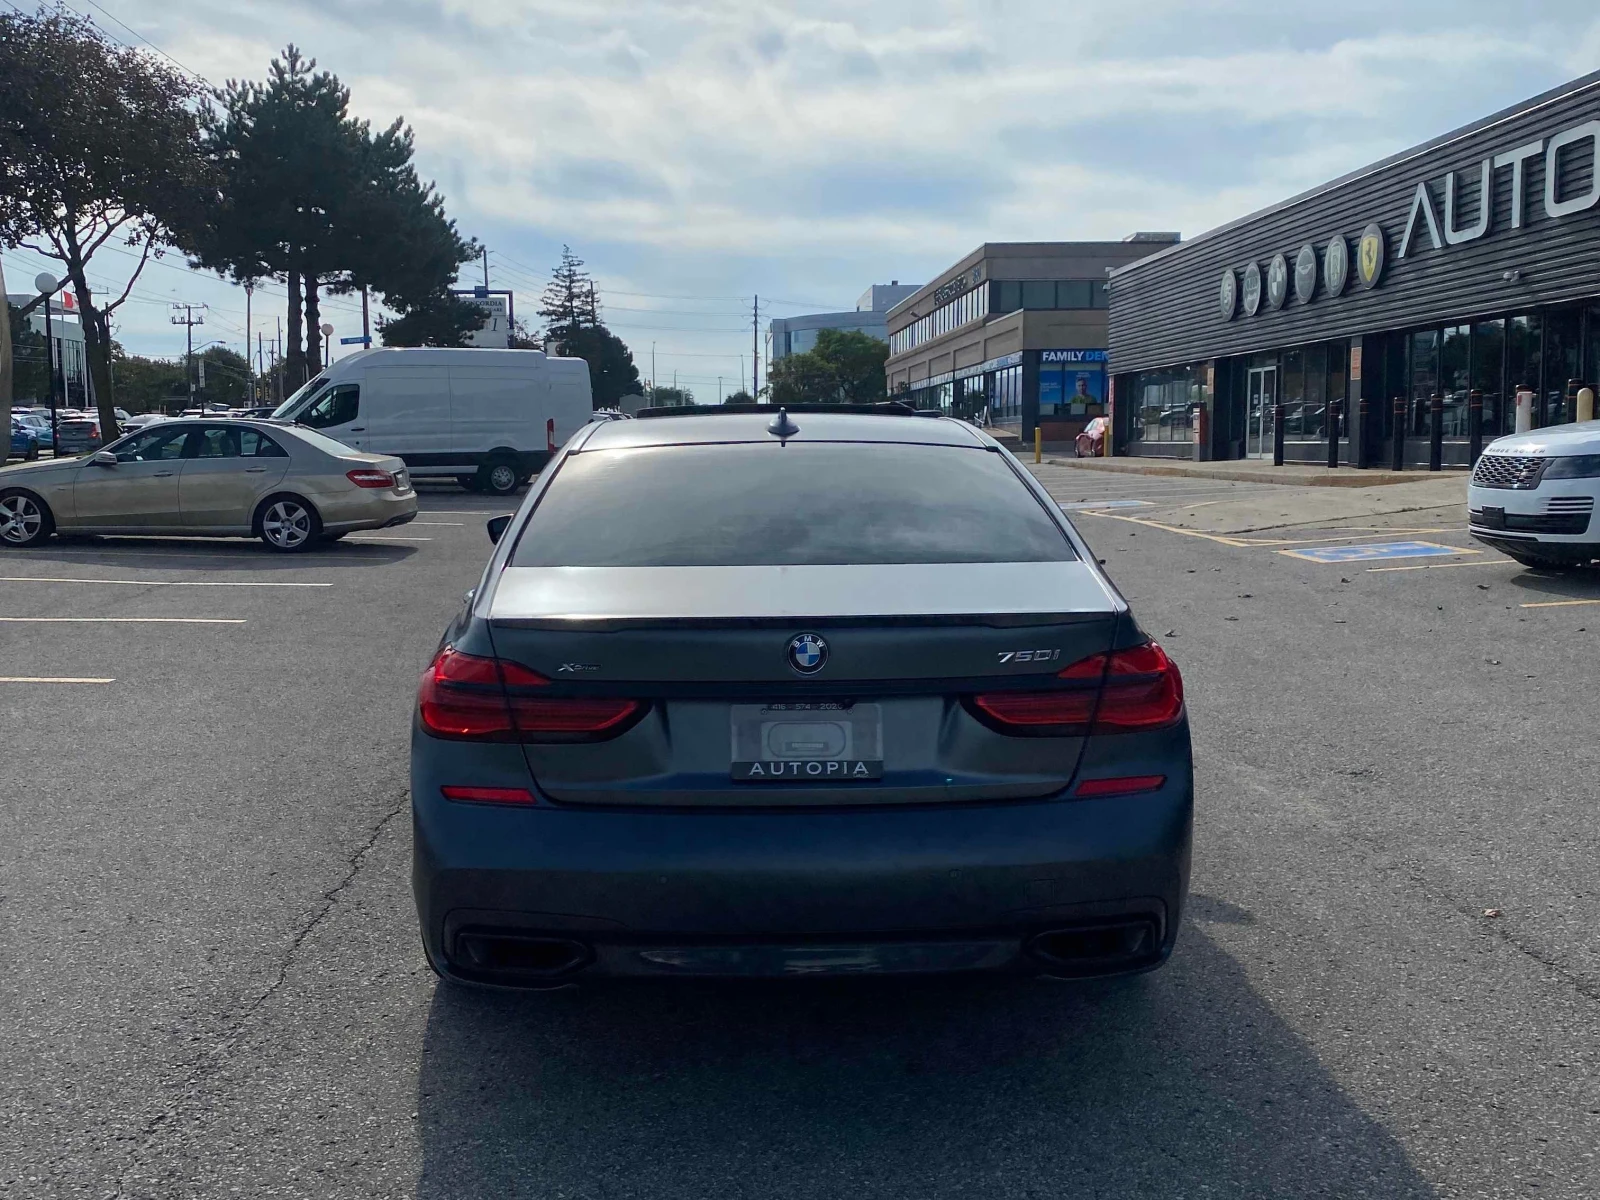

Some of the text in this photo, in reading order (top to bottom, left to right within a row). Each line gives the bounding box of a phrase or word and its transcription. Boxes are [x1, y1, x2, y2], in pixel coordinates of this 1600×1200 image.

[1398, 119, 1600, 259] AUTO
[1042, 351, 1084, 361] FAMILY
[793, 635, 825, 648] BMW
[998, 649, 1061, 663] 750i
[749, 761, 869, 776] AUTOPIA
